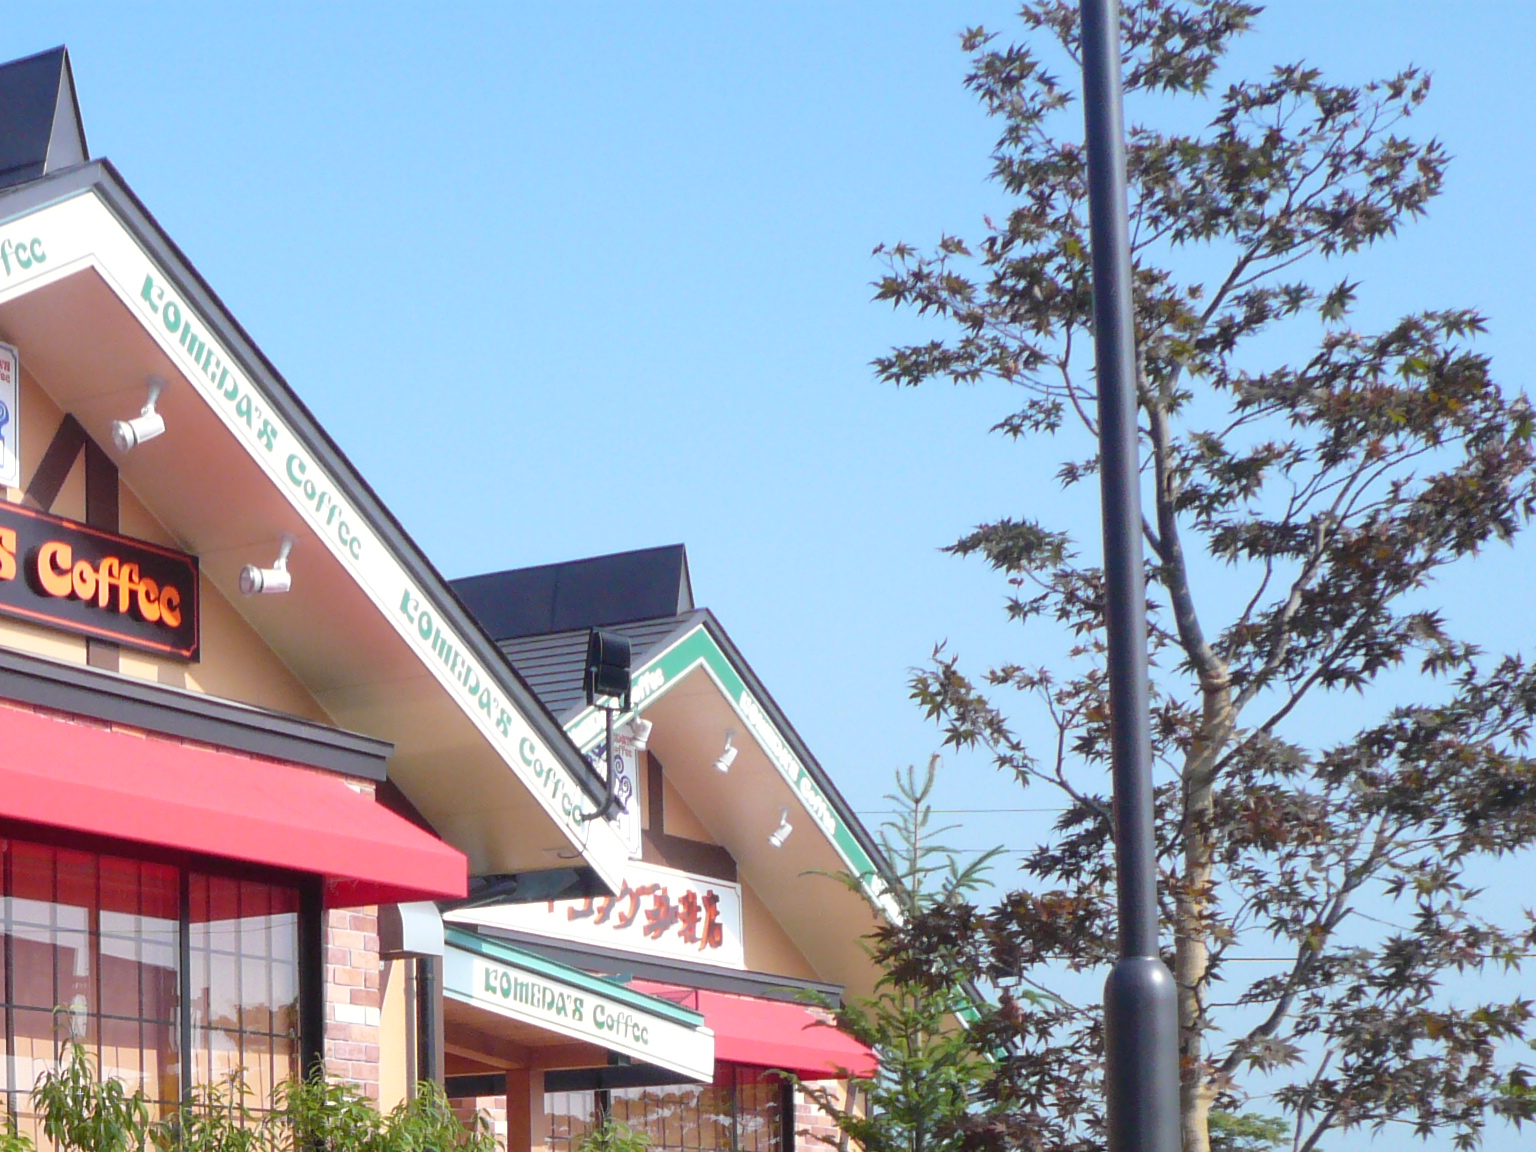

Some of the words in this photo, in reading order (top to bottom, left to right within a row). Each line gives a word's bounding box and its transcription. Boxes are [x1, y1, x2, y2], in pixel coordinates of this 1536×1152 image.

[140, 272, 278, 452] KOMEDA'S
[285, 453, 362, 560] Coffee
[38, 540, 182, 628] Coffee
[399, 588, 512, 738] KOMEDA'S
[519, 736, 583, 827] Coffee
[484, 967, 584, 1022] KOMEDA'S
[593, 1004, 648, 1045] Coffee
